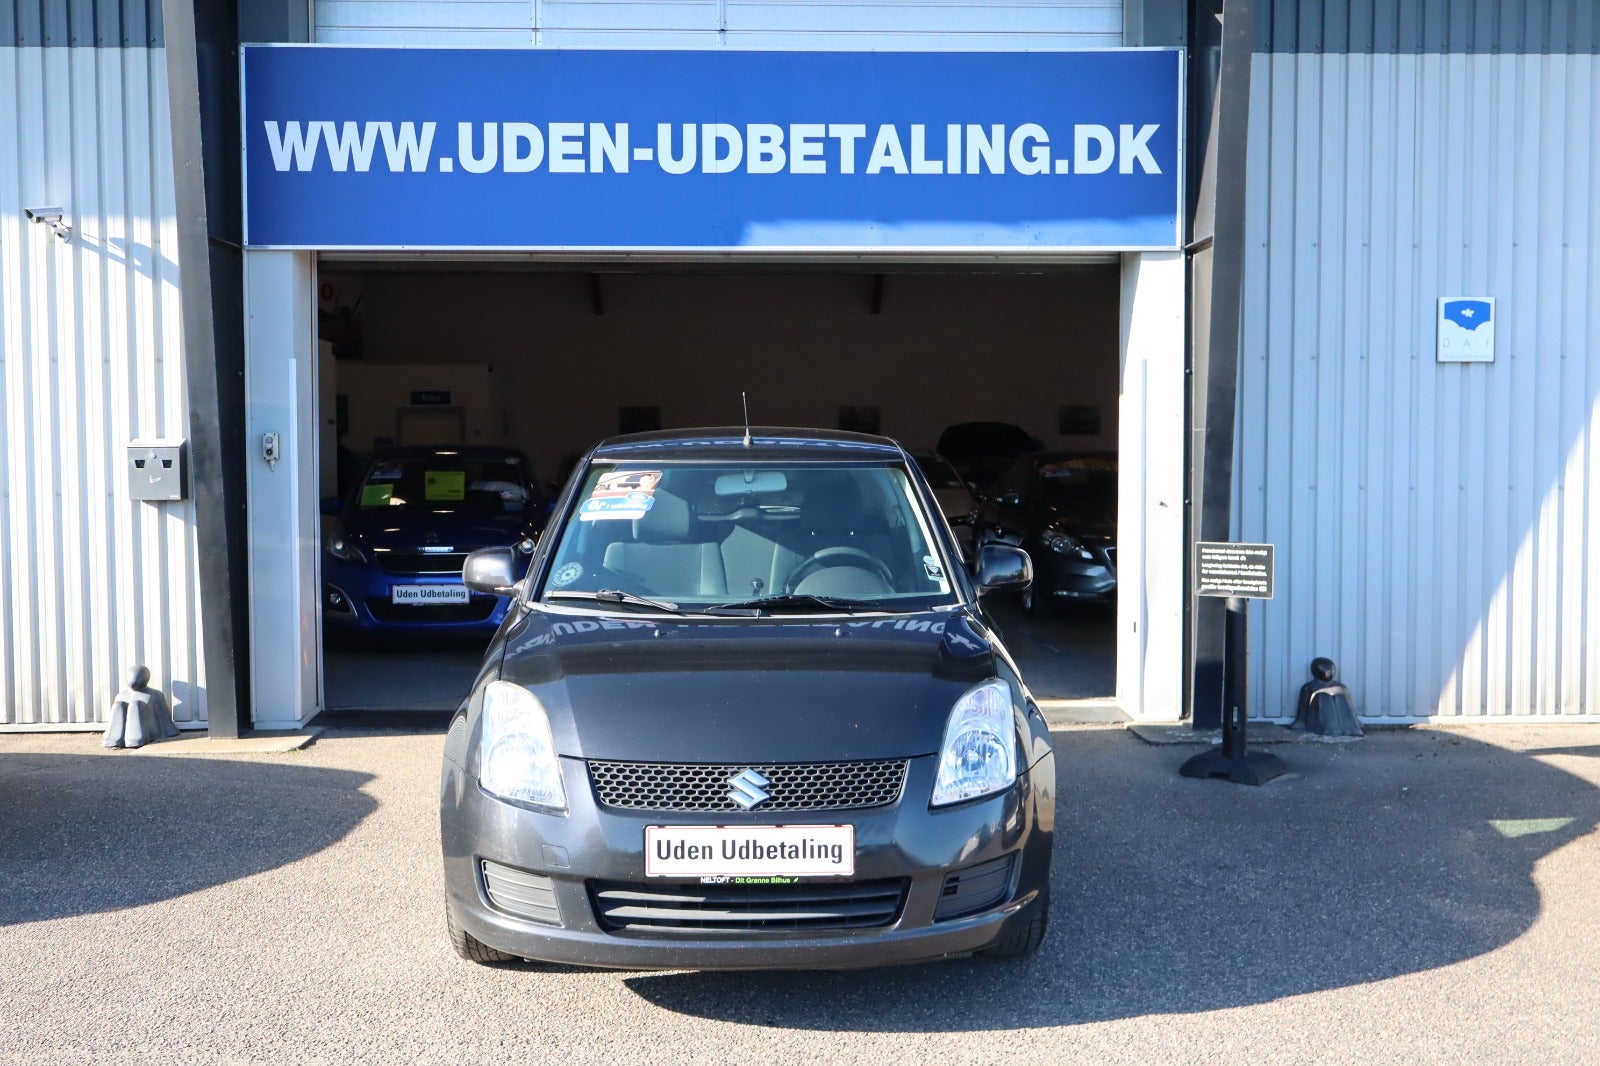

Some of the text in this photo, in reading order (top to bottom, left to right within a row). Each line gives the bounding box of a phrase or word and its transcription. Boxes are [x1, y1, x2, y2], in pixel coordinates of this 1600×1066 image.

[263, 120, 1163, 175] WWW.UDEN-UDBETALING.DK
[396, 589, 466, 599] Uden Udbetaling
[656, 838, 843, 864] Uden Udbetaling
[700, 876, 730, 884] NELTOFT
[735, 876, 745, 884] Dit
[770, 876, 791, 884] Bilhus
